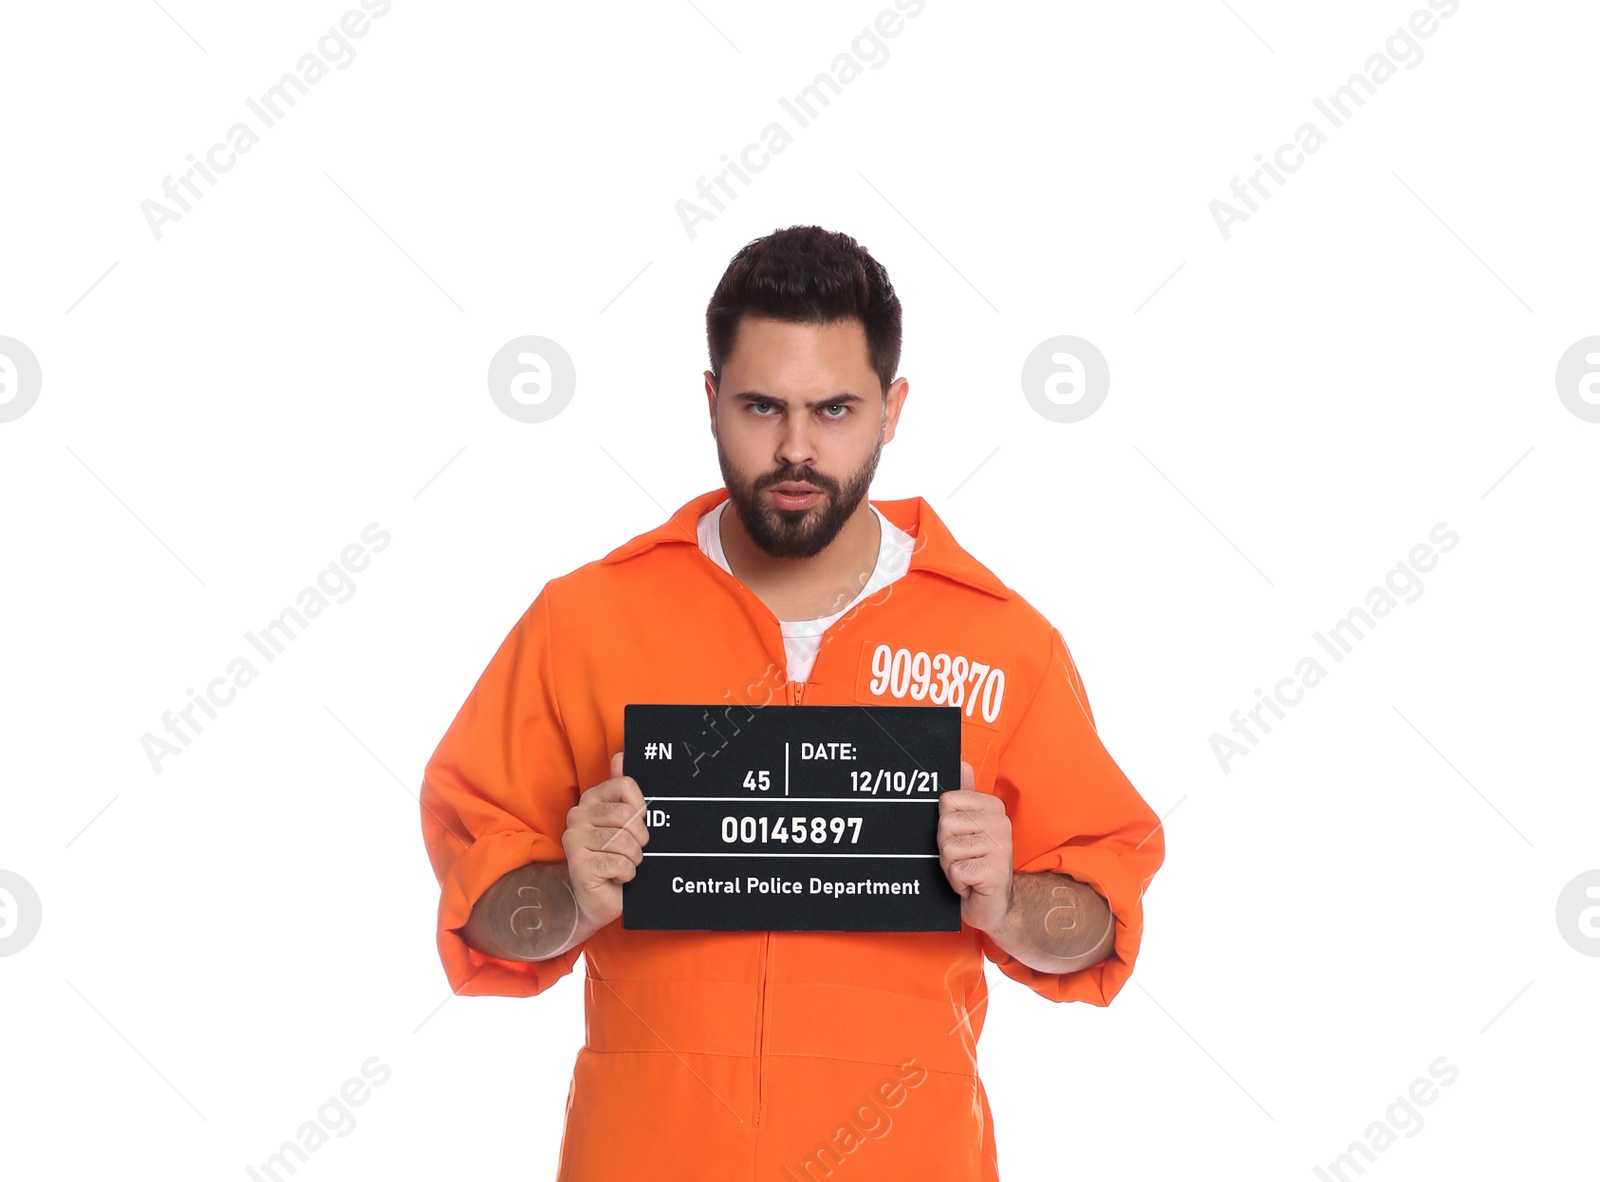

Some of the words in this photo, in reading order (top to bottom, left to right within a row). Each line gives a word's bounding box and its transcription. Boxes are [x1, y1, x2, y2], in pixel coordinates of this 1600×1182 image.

[869, 644, 1006, 724] 9093870
[644, 742, 672, 760] #N
[801, 743, 857, 760] DATE:
[742, 770, 771, 791] 45
[850, 770, 938, 795] 12/10/21
[646, 809, 671, 827] ID:
[721, 816, 863, 844] 00145897
[672, 877, 741, 894] Central
[747, 877, 803, 894] Police
[809, 878, 920, 899] Department
